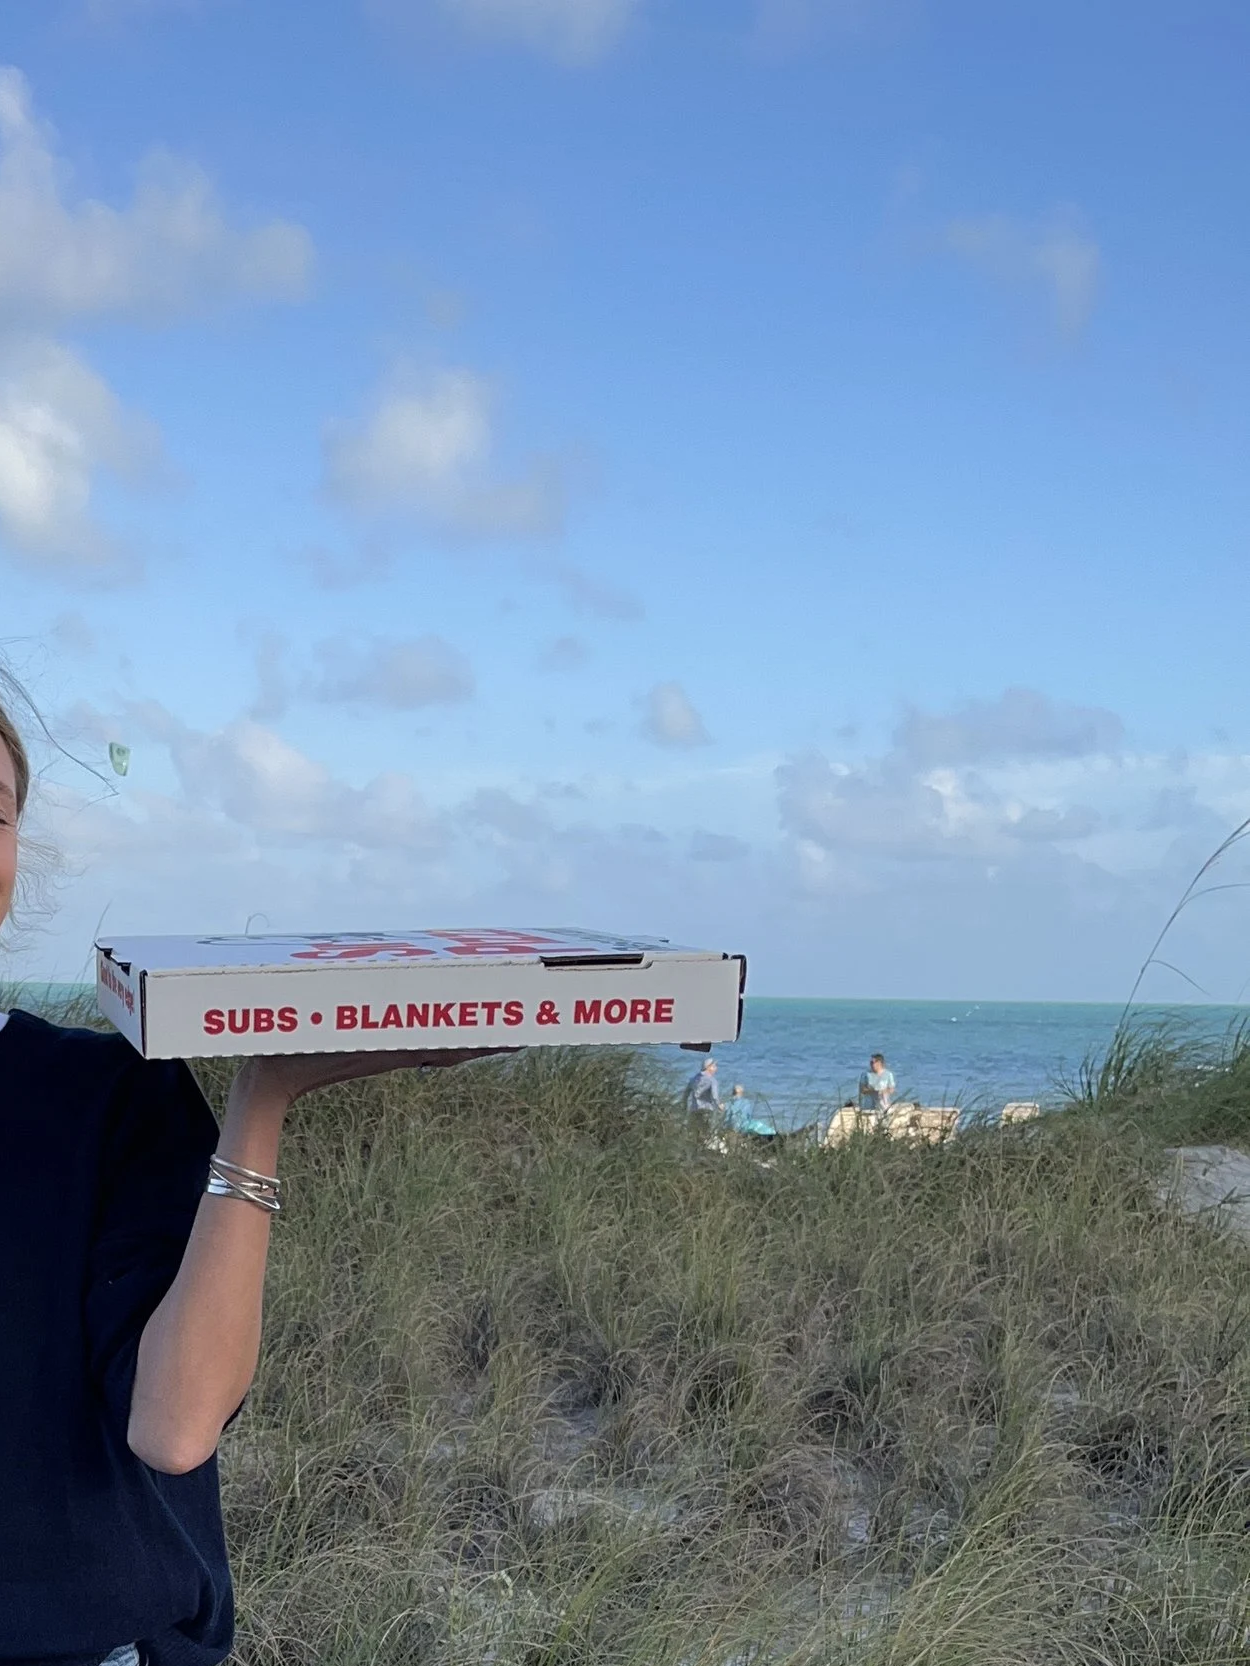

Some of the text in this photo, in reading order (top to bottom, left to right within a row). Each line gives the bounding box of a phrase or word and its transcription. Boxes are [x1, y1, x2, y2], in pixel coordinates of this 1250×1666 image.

[203, 998, 673, 1036] SUBS BLANKETS & MORE
